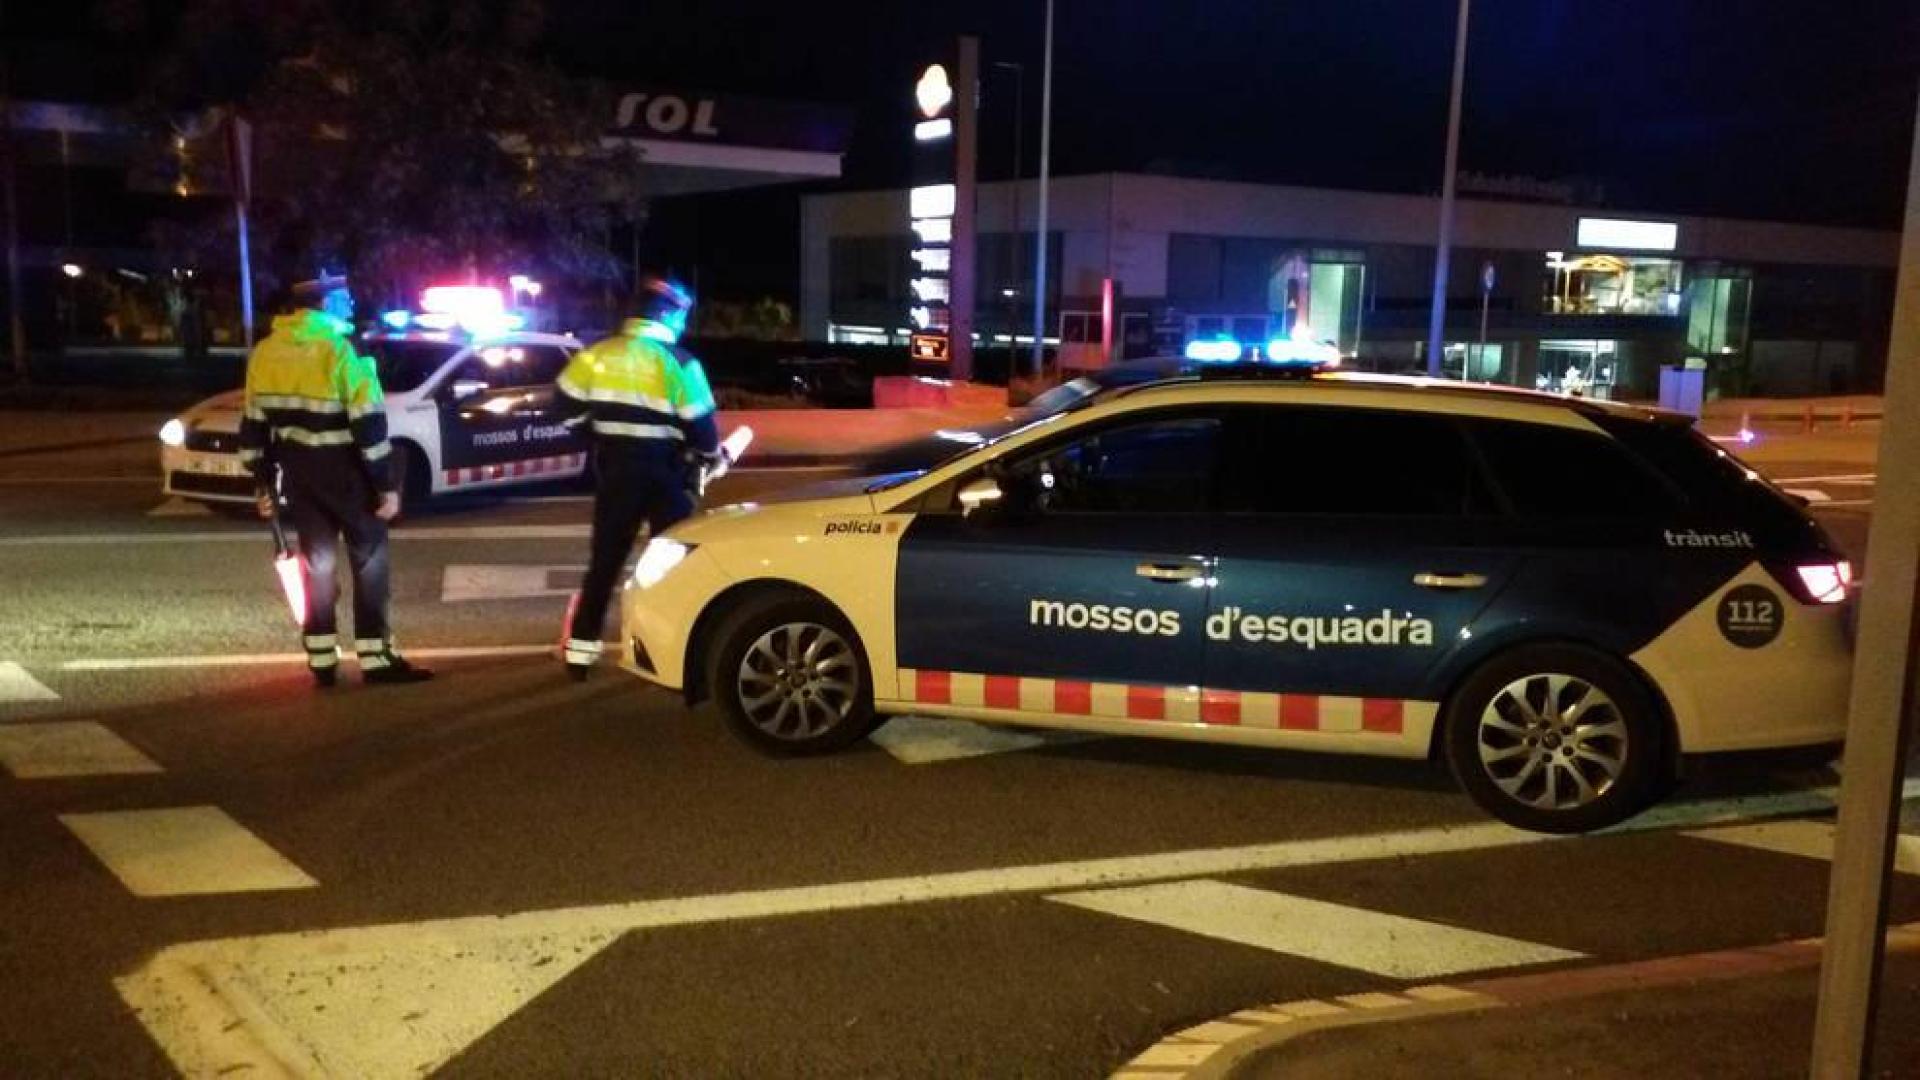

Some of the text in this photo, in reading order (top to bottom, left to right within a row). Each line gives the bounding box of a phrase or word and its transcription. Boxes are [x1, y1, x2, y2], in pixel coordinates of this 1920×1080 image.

[823, 519, 881, 536] policia
[1029, 597, 1433, 649] mossos d'esquadra
[1727, 601, 1774, 624] 112
